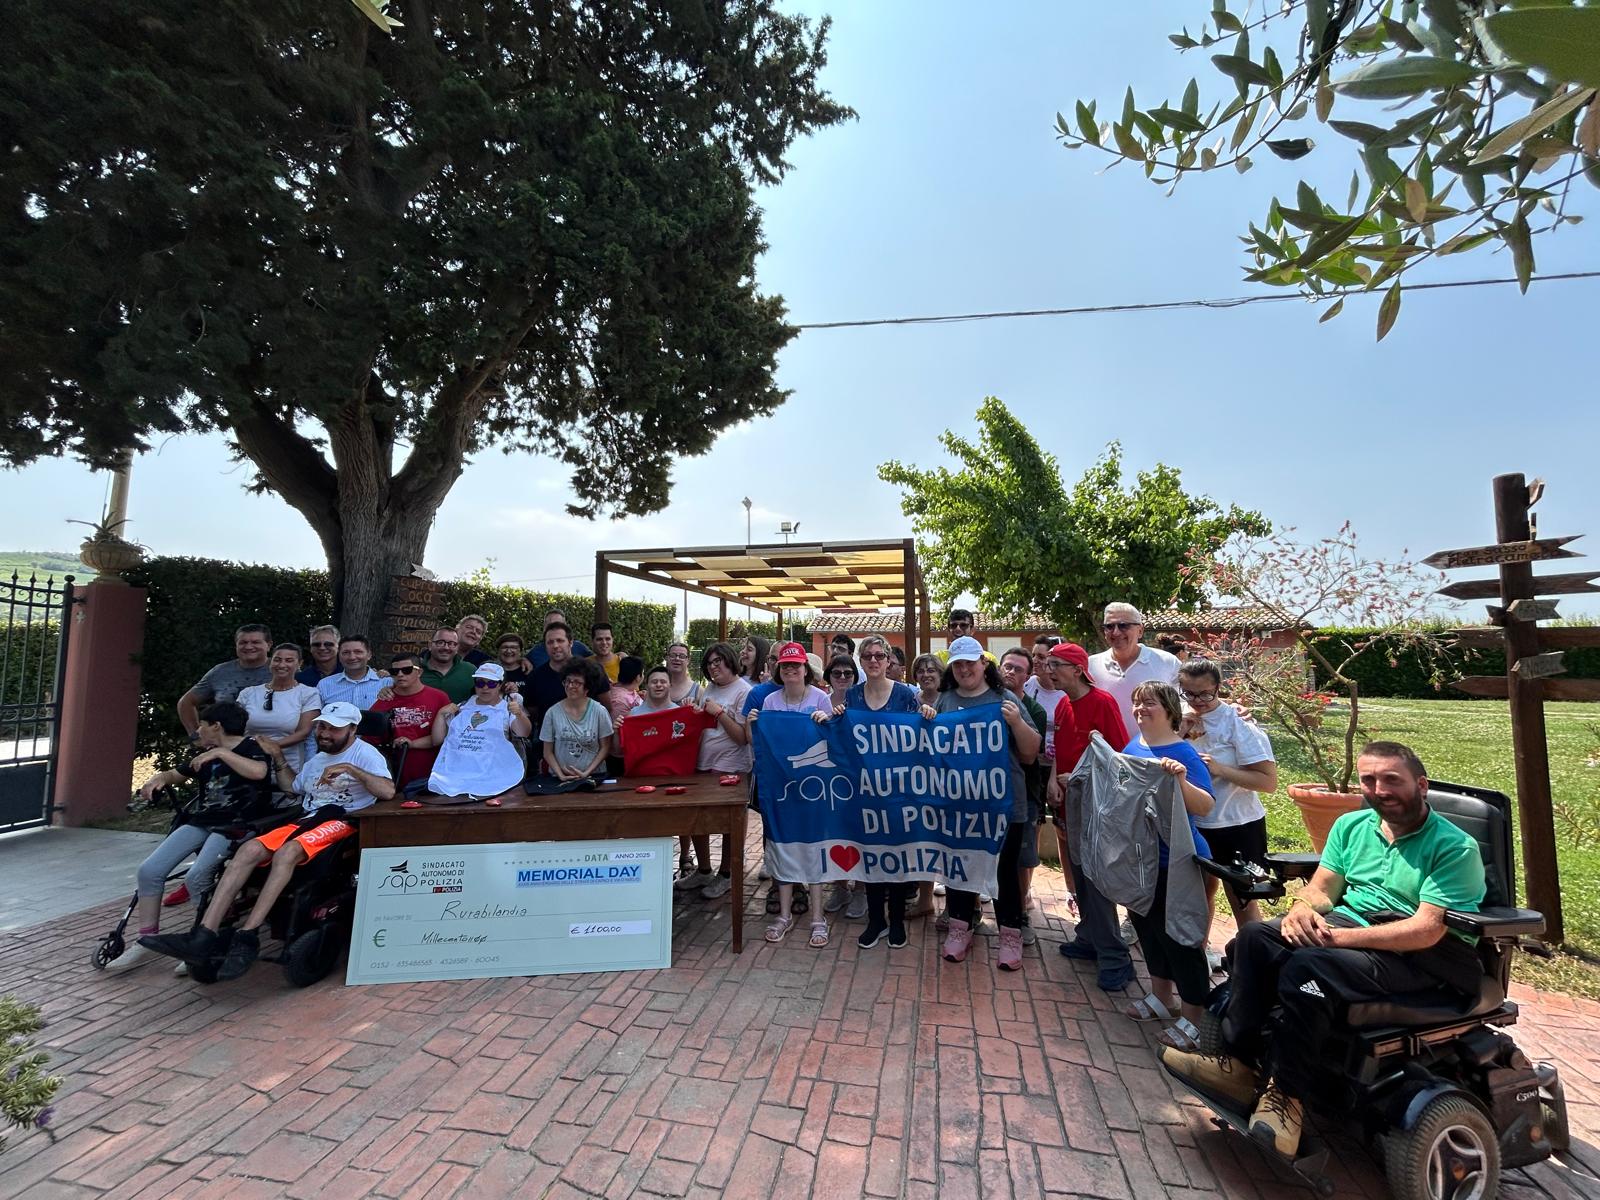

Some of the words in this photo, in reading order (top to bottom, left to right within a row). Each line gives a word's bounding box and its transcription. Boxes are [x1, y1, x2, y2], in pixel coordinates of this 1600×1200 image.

[408, 590, 432, 603] oca
[853, 720, 1003, 755] SINDACATO
[860, 765, 1006, 800] AUTONOMO
[862, 808, 890, 834] DI
[902, 805, 1008, 841] POLIZIA
[422, 861, 465, 869] SINDACATO
[584, 854, 609, 862] DATA
[821, 848, 828, 874] I
[862, 848, 968, 882] POLIZIA
[420, 878, 463, 886] POLIZIA
[518, 868, 604, 882] MEMORIAL
[608, 866, 640, 878] DAY
[440, 900, 527, 920] Rurabilandia
[372, 929, 387, 947] €
